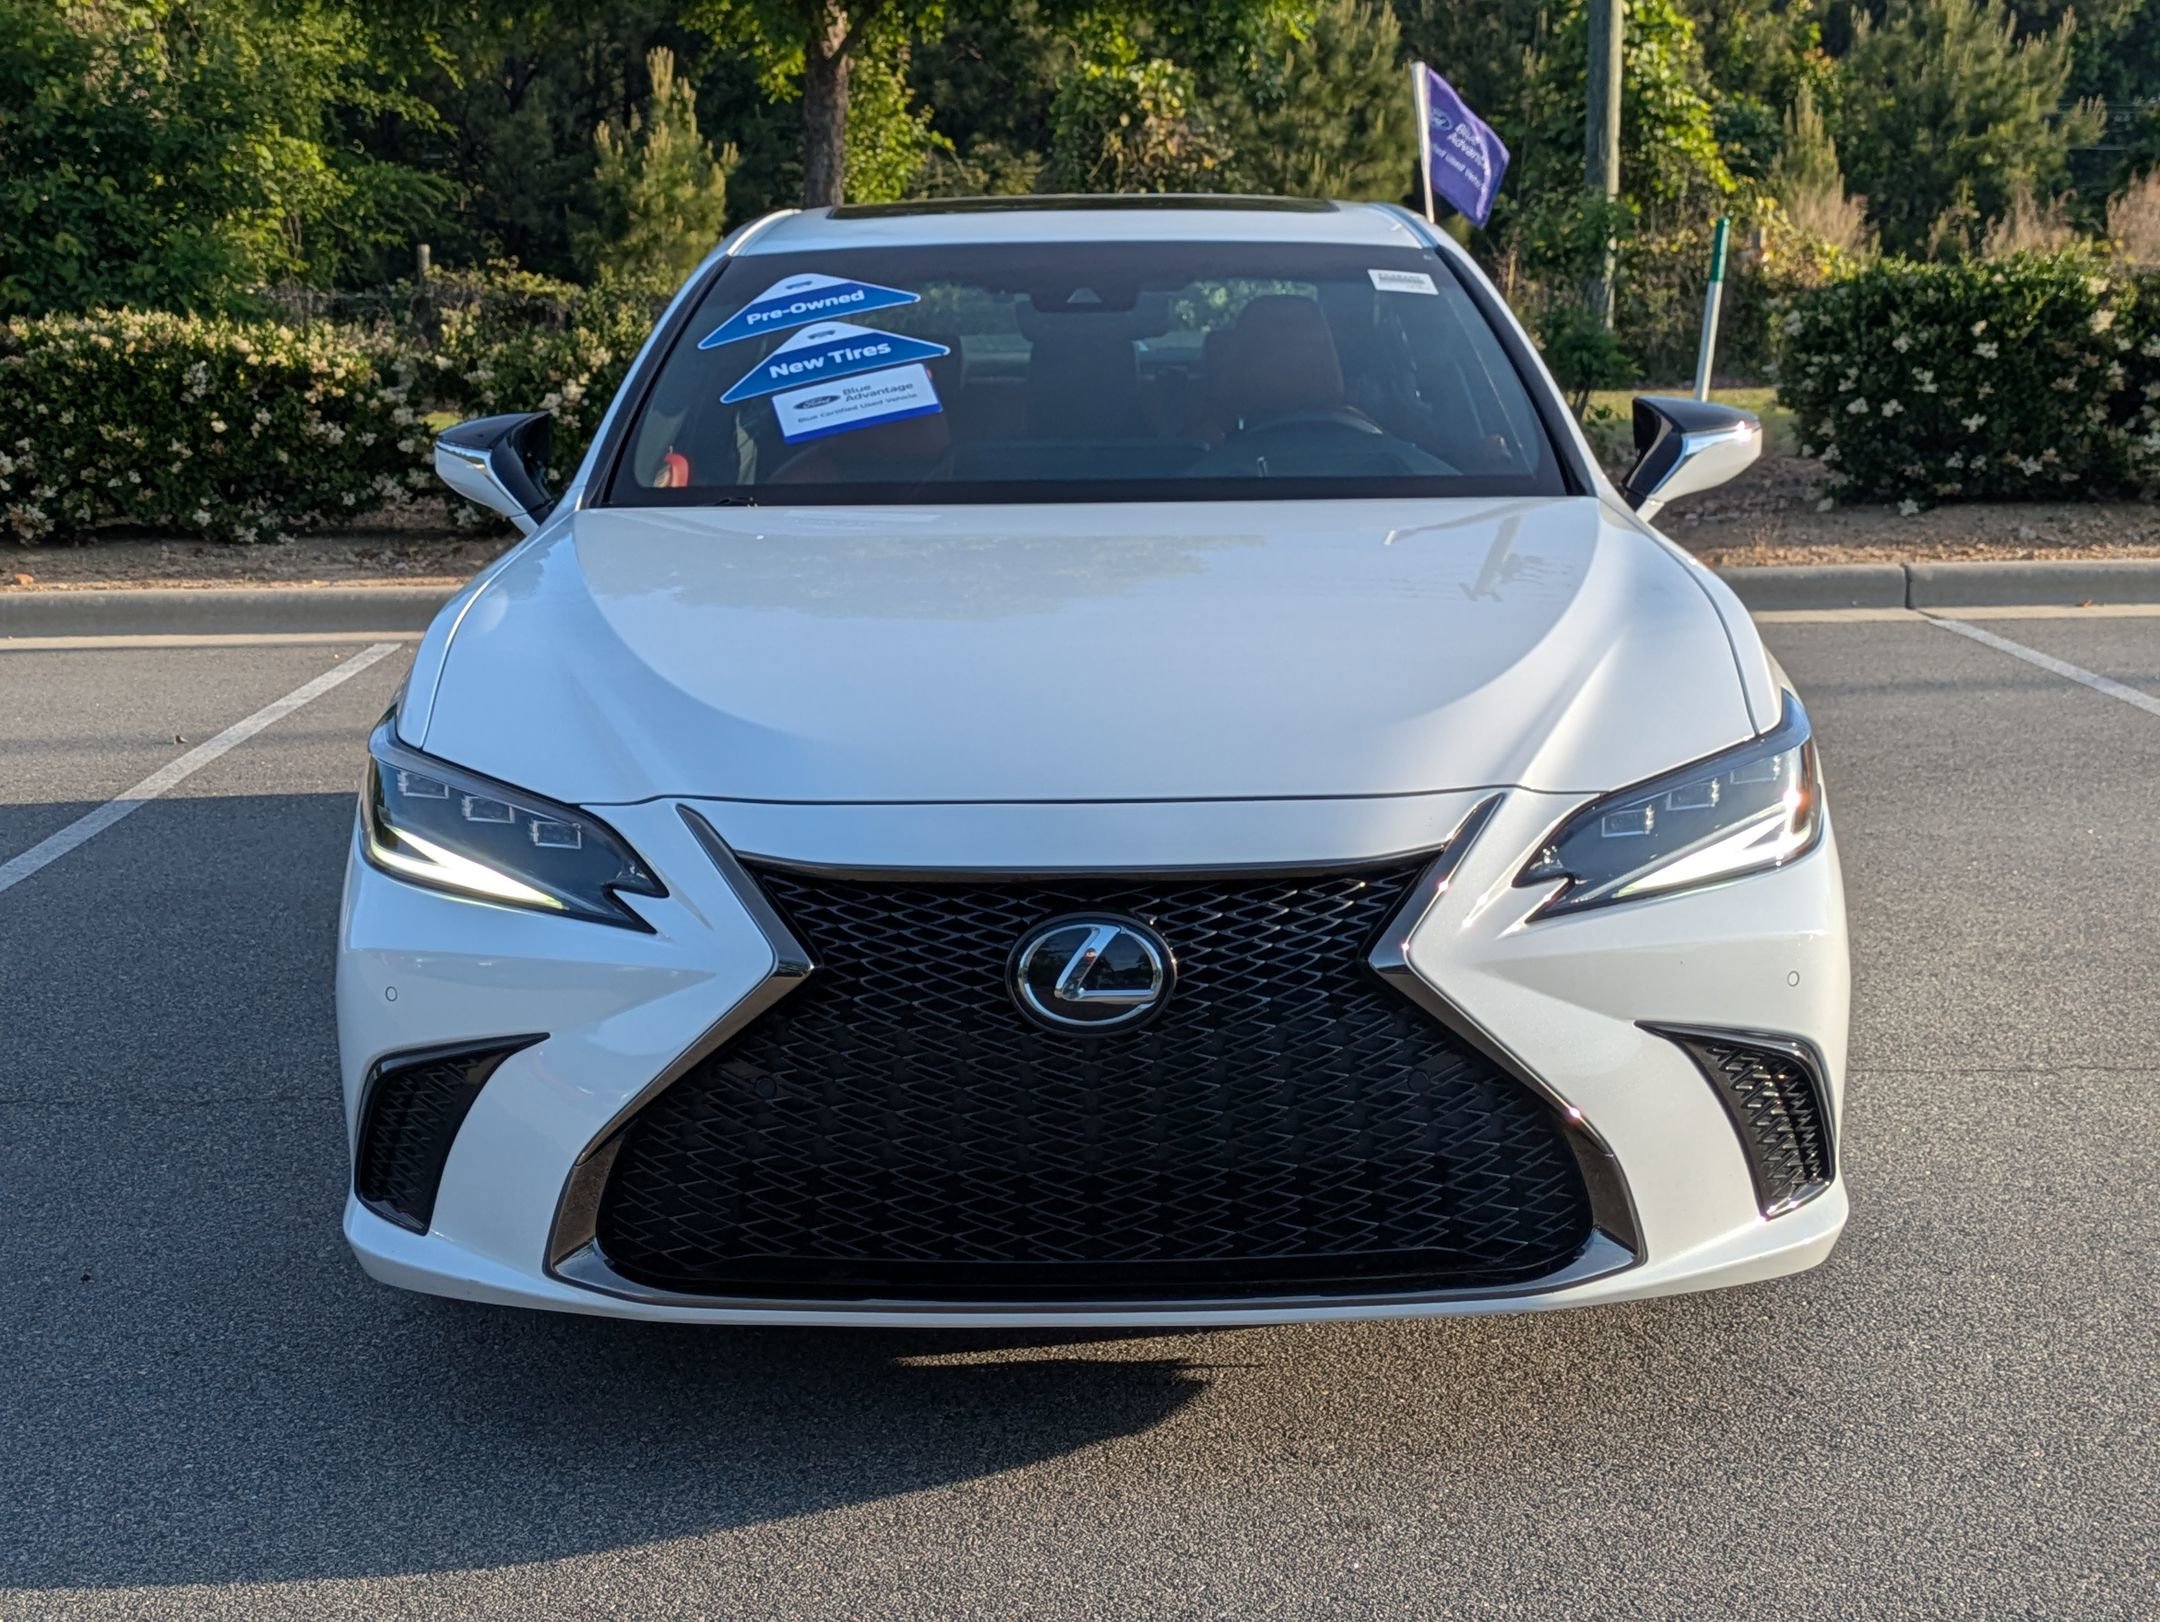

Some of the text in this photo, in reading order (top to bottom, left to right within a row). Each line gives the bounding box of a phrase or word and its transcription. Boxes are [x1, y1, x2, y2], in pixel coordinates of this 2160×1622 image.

[746, 290, 866, 325] Pre-Owned
[769, 343, 892, 379] New Tires
[842, 384, 872, 396] Blue
[845, 382, 914, 402] Advantage
